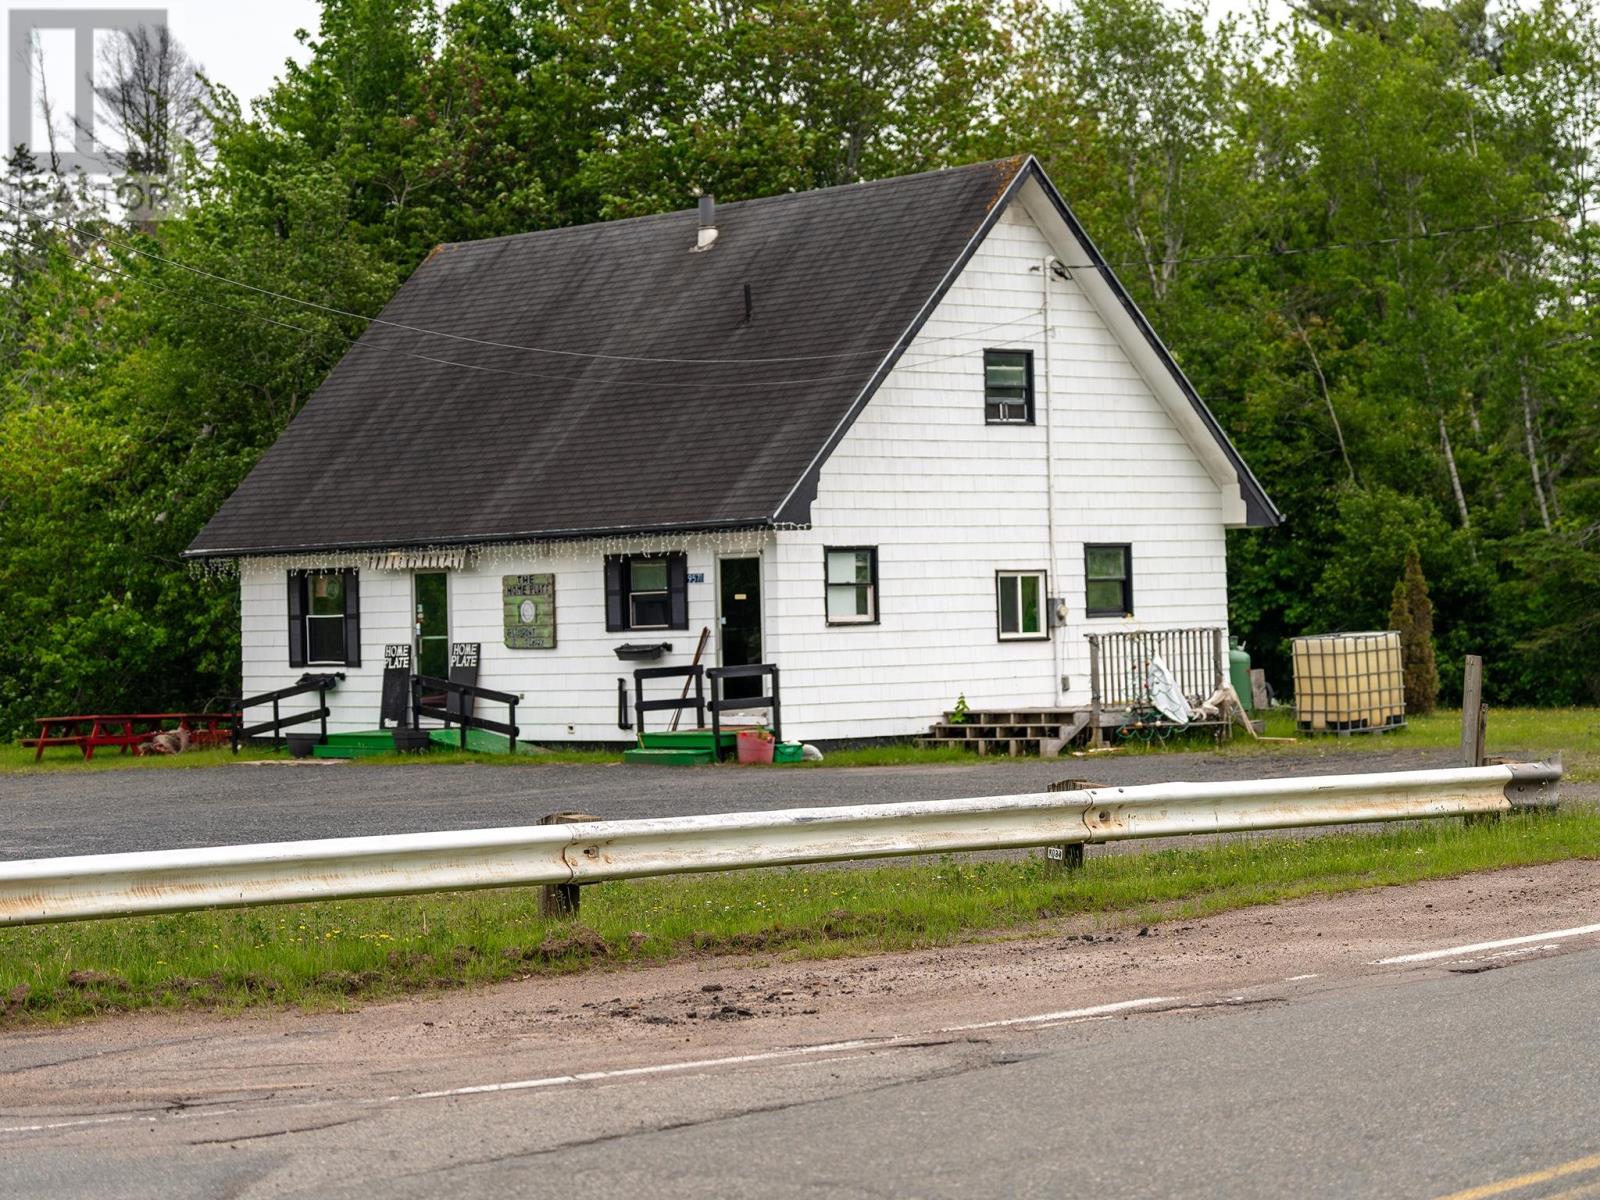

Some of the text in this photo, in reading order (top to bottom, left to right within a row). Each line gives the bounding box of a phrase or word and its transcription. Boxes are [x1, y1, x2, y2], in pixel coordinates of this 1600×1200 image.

[517, 575, 534, 584] THE
[384, 645, 409, 657] HOME
[453, 643, 478, 656] HOME
[384, 656, 410, 669] PLATE
[450, 655, 477, 667] PLATE
